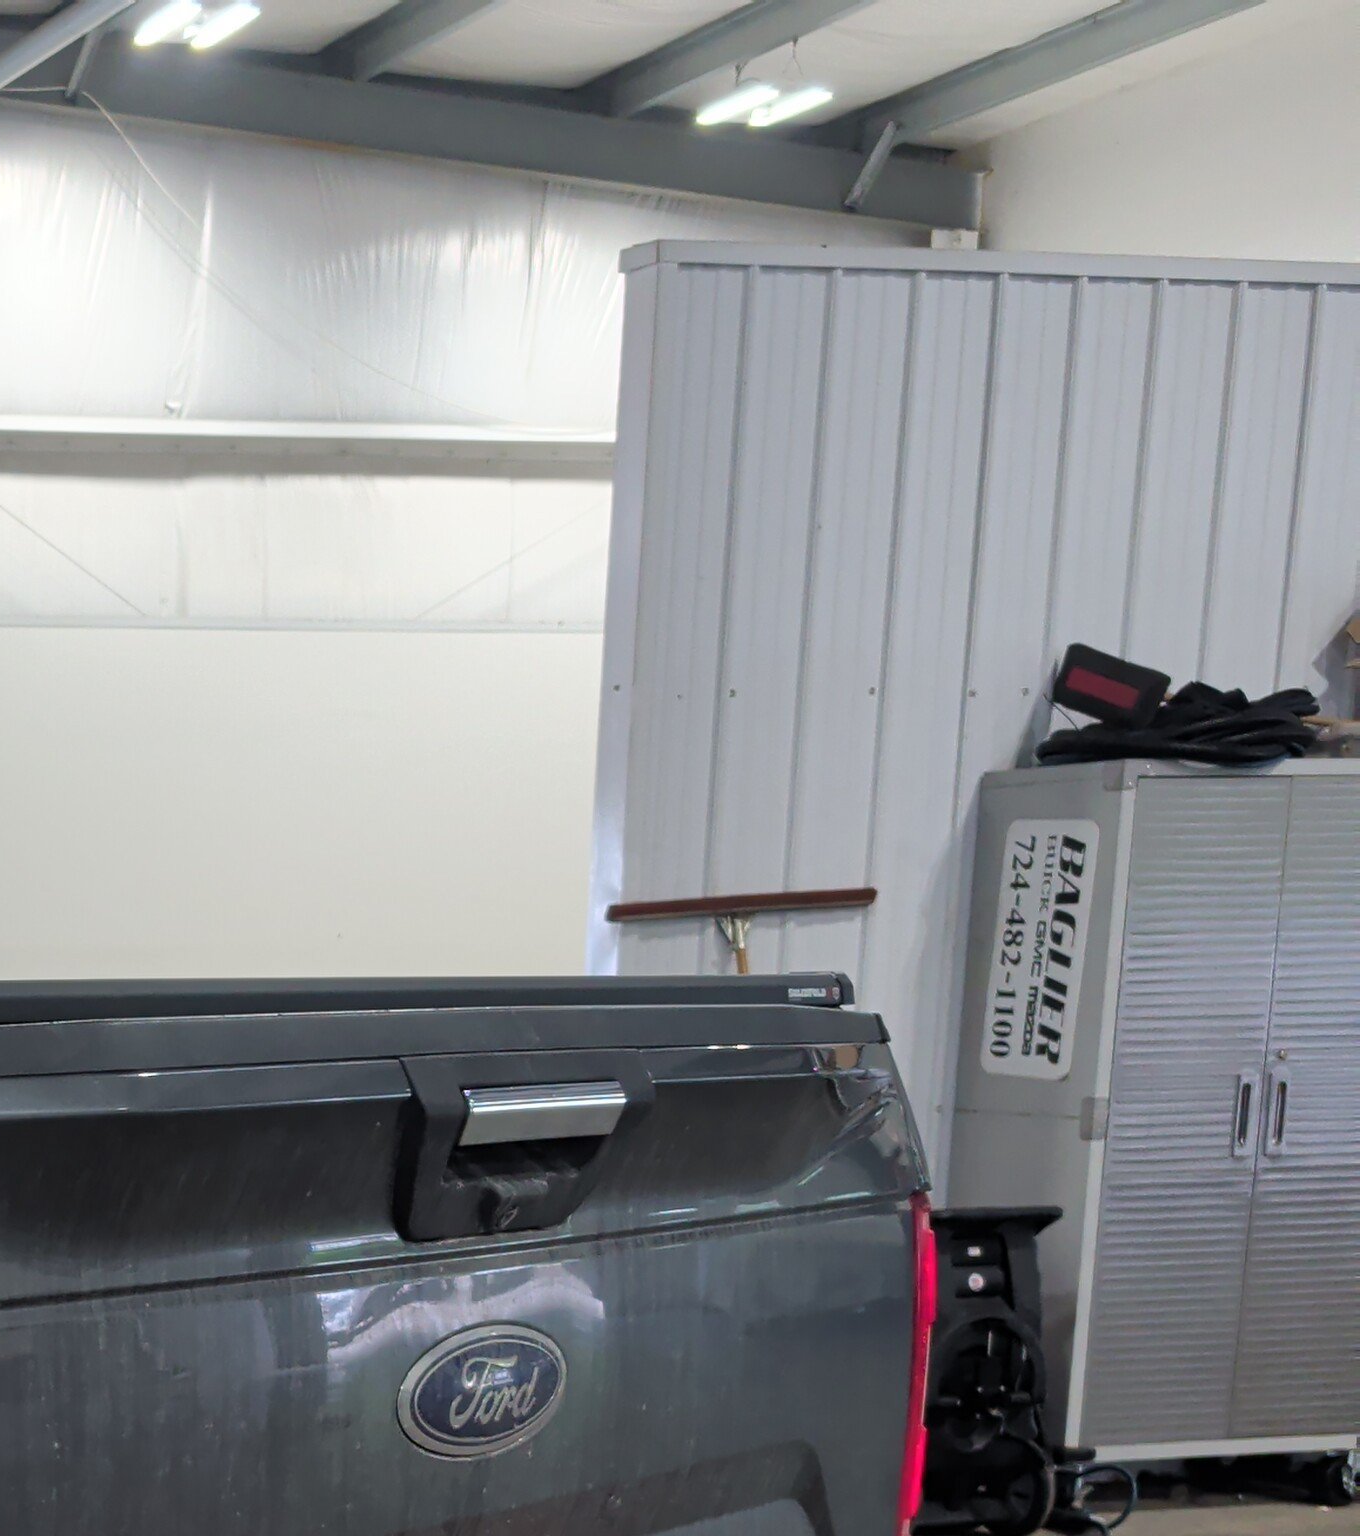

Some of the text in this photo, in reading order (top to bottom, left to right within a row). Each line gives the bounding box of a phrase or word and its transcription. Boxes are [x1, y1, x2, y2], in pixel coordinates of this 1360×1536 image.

[1039, 835, 1057, 911] BUICK
[990, 835, 1036, 1057] 724-482-1100
[1030, 920, 1047, 977] GMC
[1035, 834, 1086, 1064] BAGLIER
[449, 1355, 539, 1430] Ford
